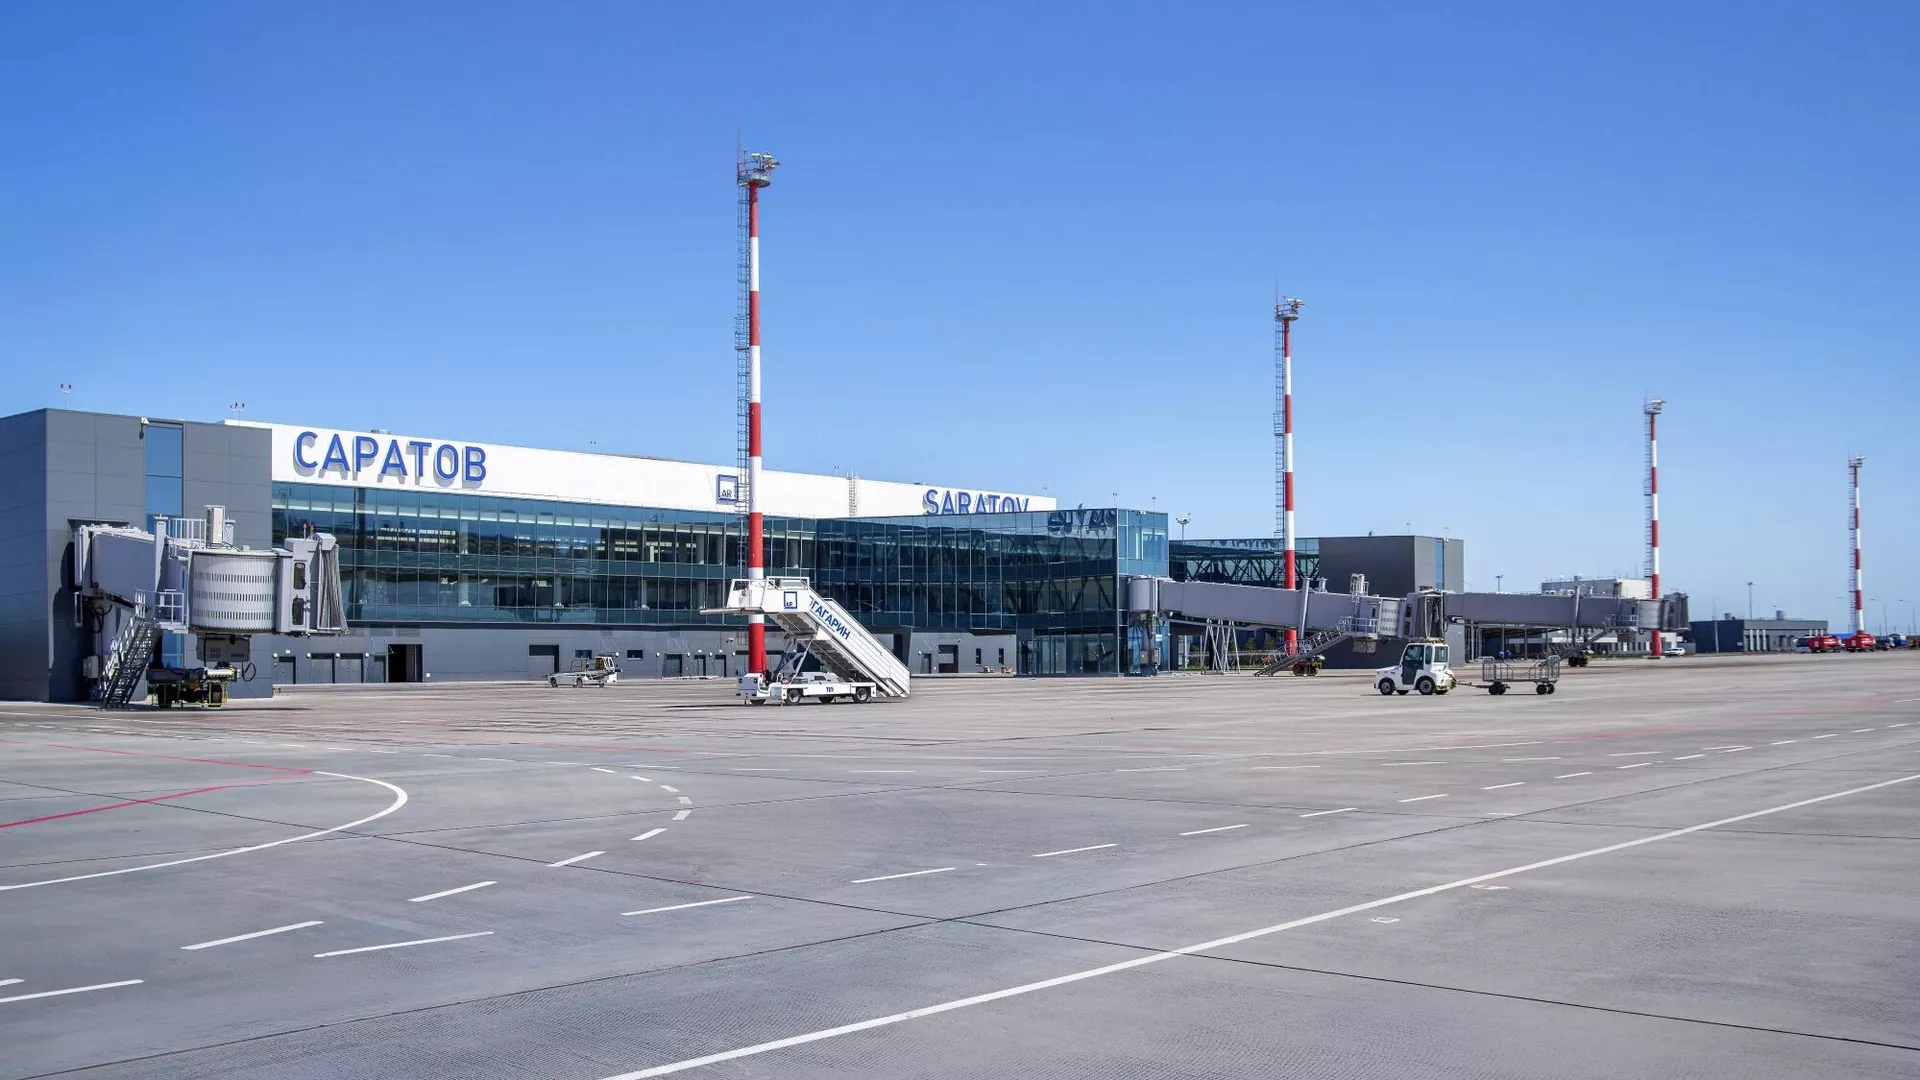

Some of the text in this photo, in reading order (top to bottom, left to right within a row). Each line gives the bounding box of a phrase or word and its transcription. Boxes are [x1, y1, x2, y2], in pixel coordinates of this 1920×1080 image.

[295, 431, 487, 482] САРАТОВ
[924, 489, 1029, 516] SARATOV
[810, 600, 851, 640] ГАГАРИН
